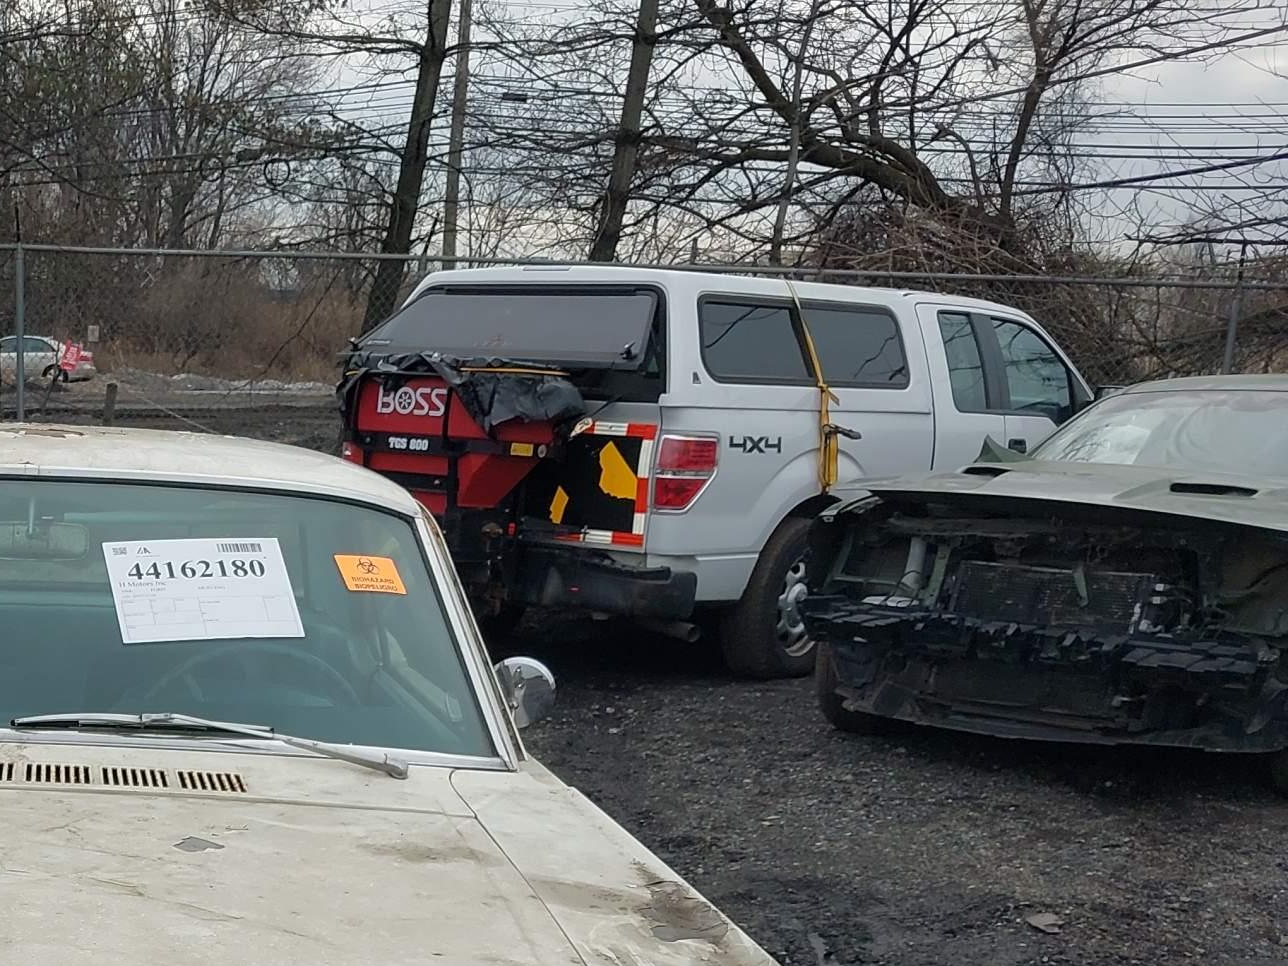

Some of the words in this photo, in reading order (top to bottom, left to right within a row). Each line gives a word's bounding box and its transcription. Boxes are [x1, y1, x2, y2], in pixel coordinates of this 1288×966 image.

[377, 386, 448, 417] BOSS
[388, 436, 407, 449] TGS
[127, 559, 266, 580] 44162180
